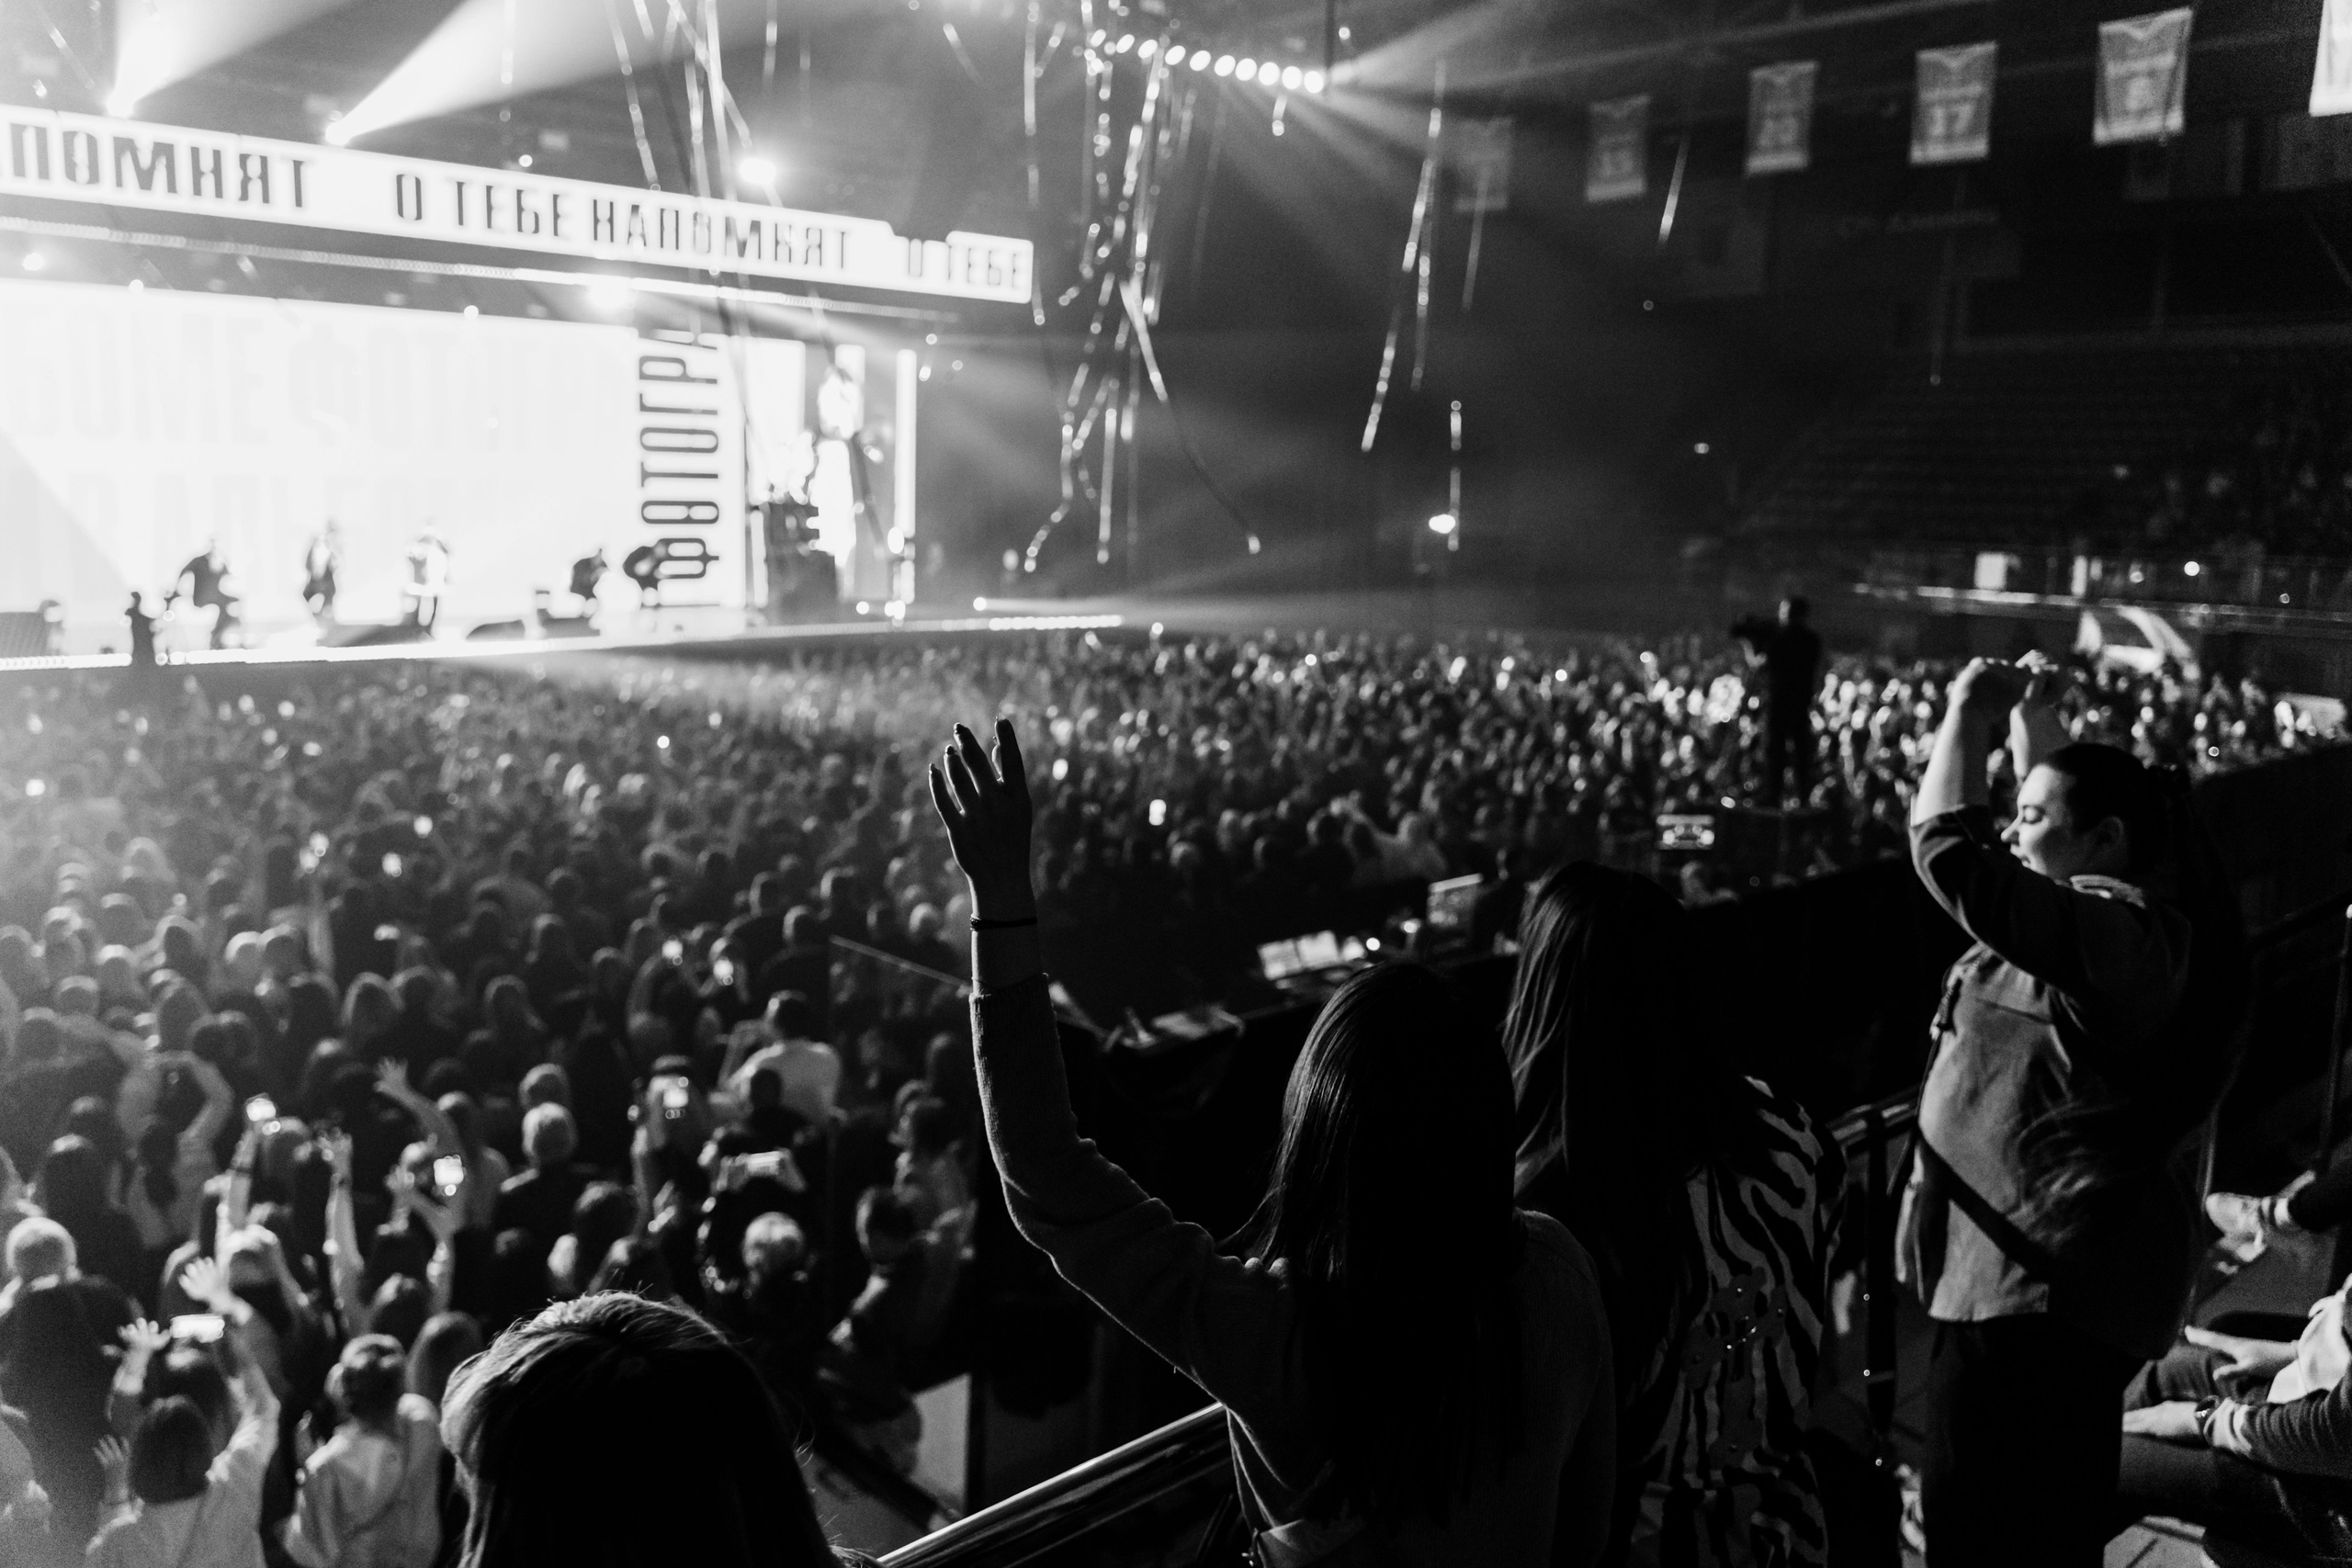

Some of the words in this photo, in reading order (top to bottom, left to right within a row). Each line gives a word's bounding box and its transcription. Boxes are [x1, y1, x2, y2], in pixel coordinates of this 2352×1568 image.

[396, 173, 424, 221] О
[447, 178, 573, 241] ТЕБЕ
[592, 197, 851, 269] НАПОМНЯТ
